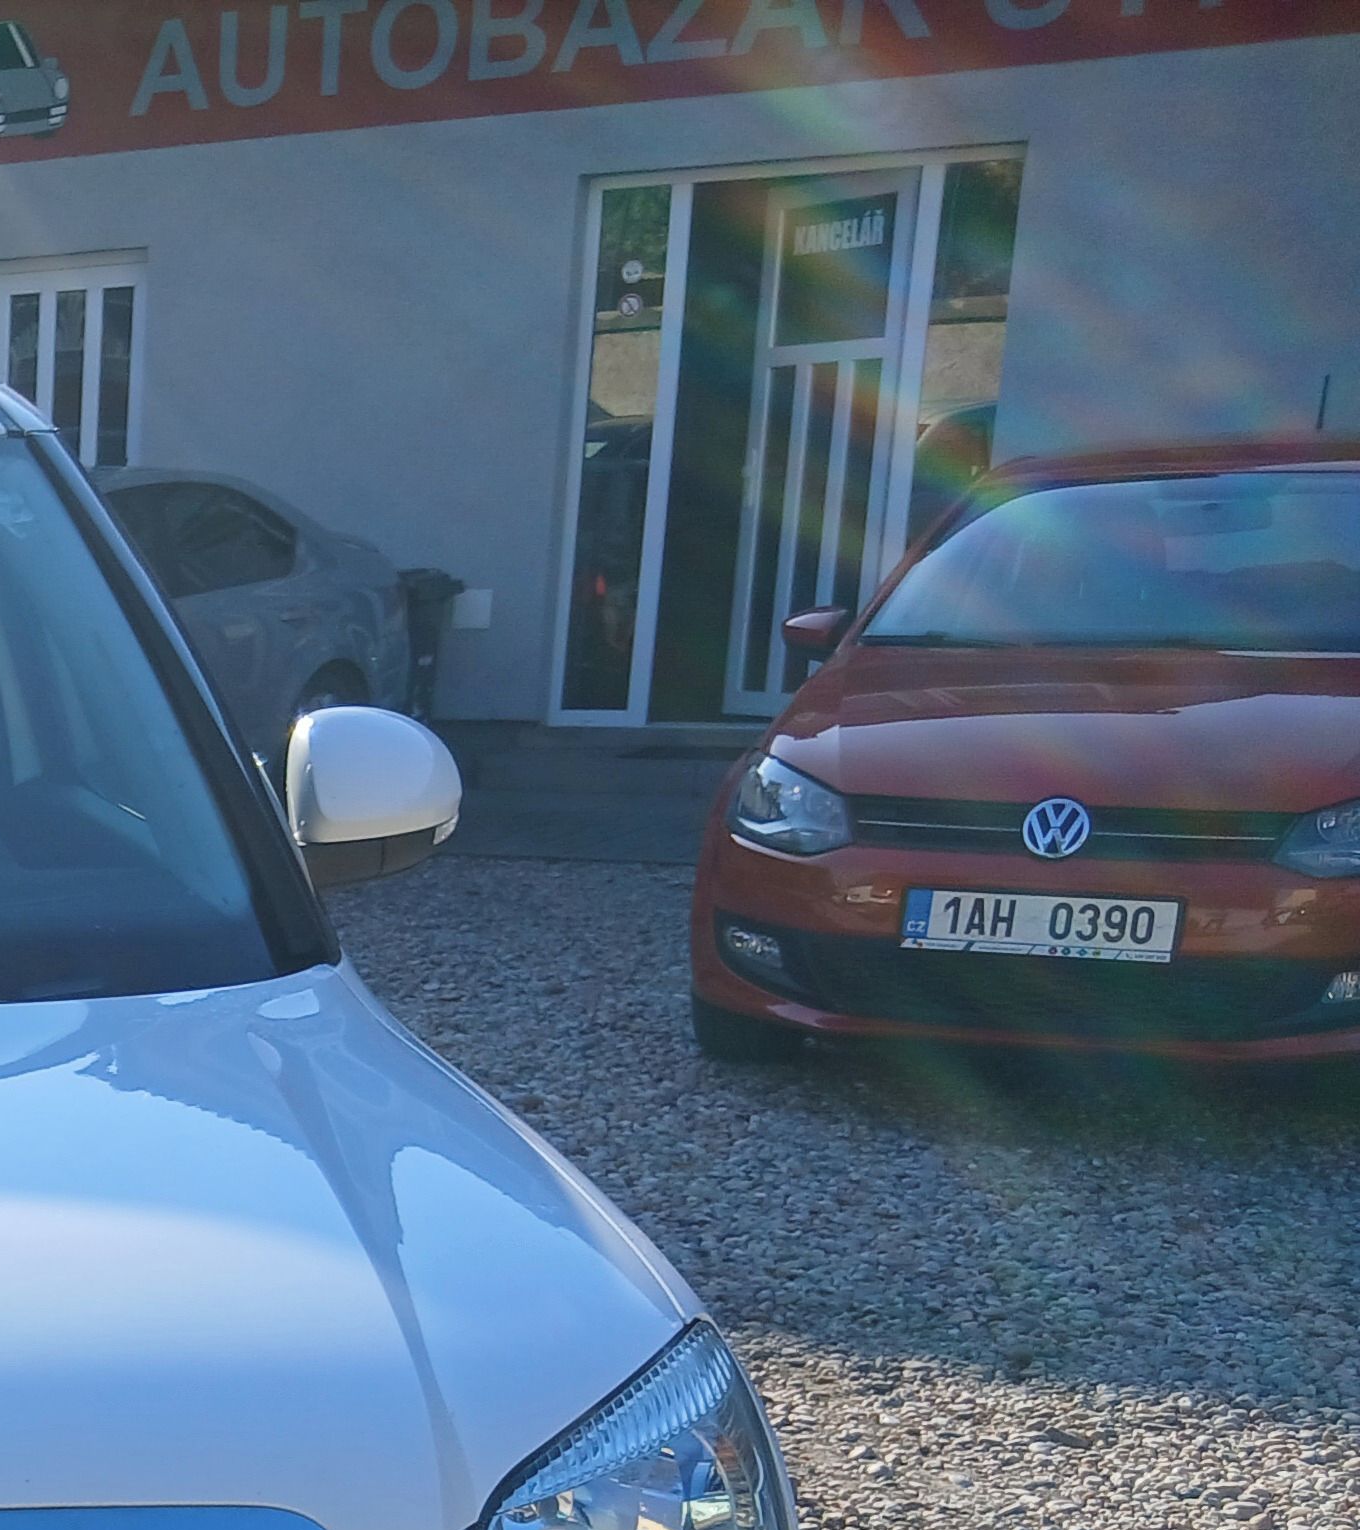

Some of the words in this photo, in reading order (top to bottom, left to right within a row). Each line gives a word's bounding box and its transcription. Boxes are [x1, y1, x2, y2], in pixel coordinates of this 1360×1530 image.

[906, 920, 926, 933] CZ
[943, 896, 1017, 938] 1AH
[1048, 902, 1156, 945] 0390
